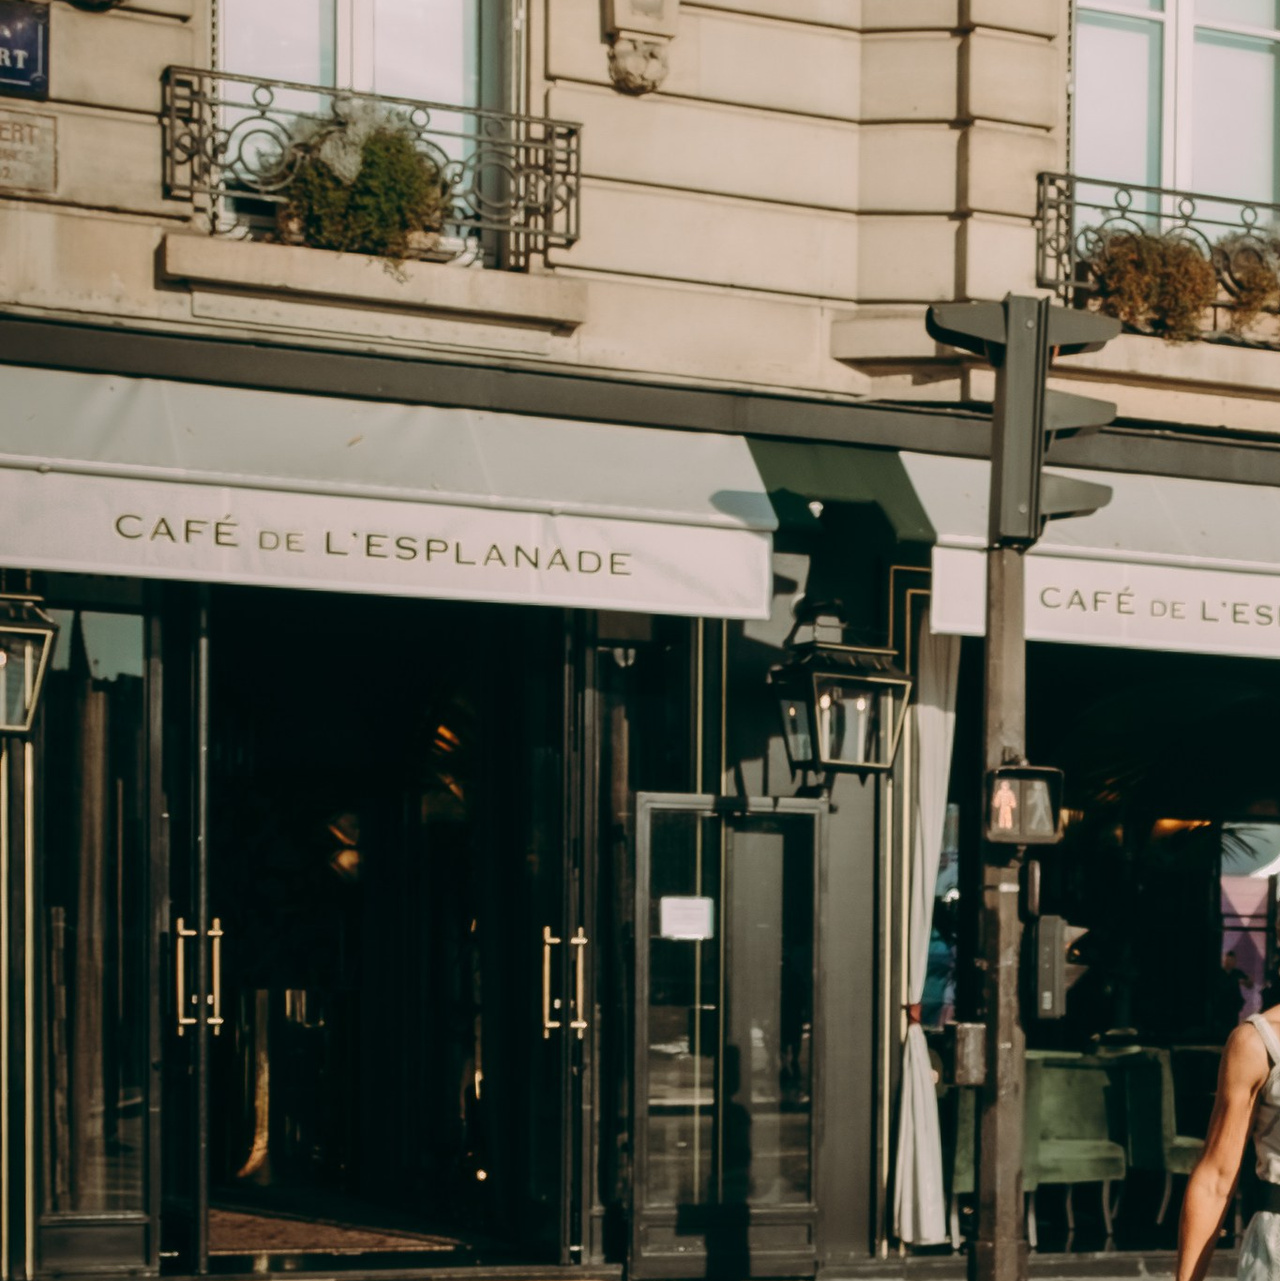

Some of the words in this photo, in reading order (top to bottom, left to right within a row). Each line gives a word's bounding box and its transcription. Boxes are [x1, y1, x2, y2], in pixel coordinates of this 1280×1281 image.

[114, 513, 240, 548] CAFÉ
[258, 530, 305, 553] DE
[324, 530, 633, 577] L'ESPLANADE
[1038, 585, 1136, 616] CAFÉ
[1150, 599, 1186, 620] DE
